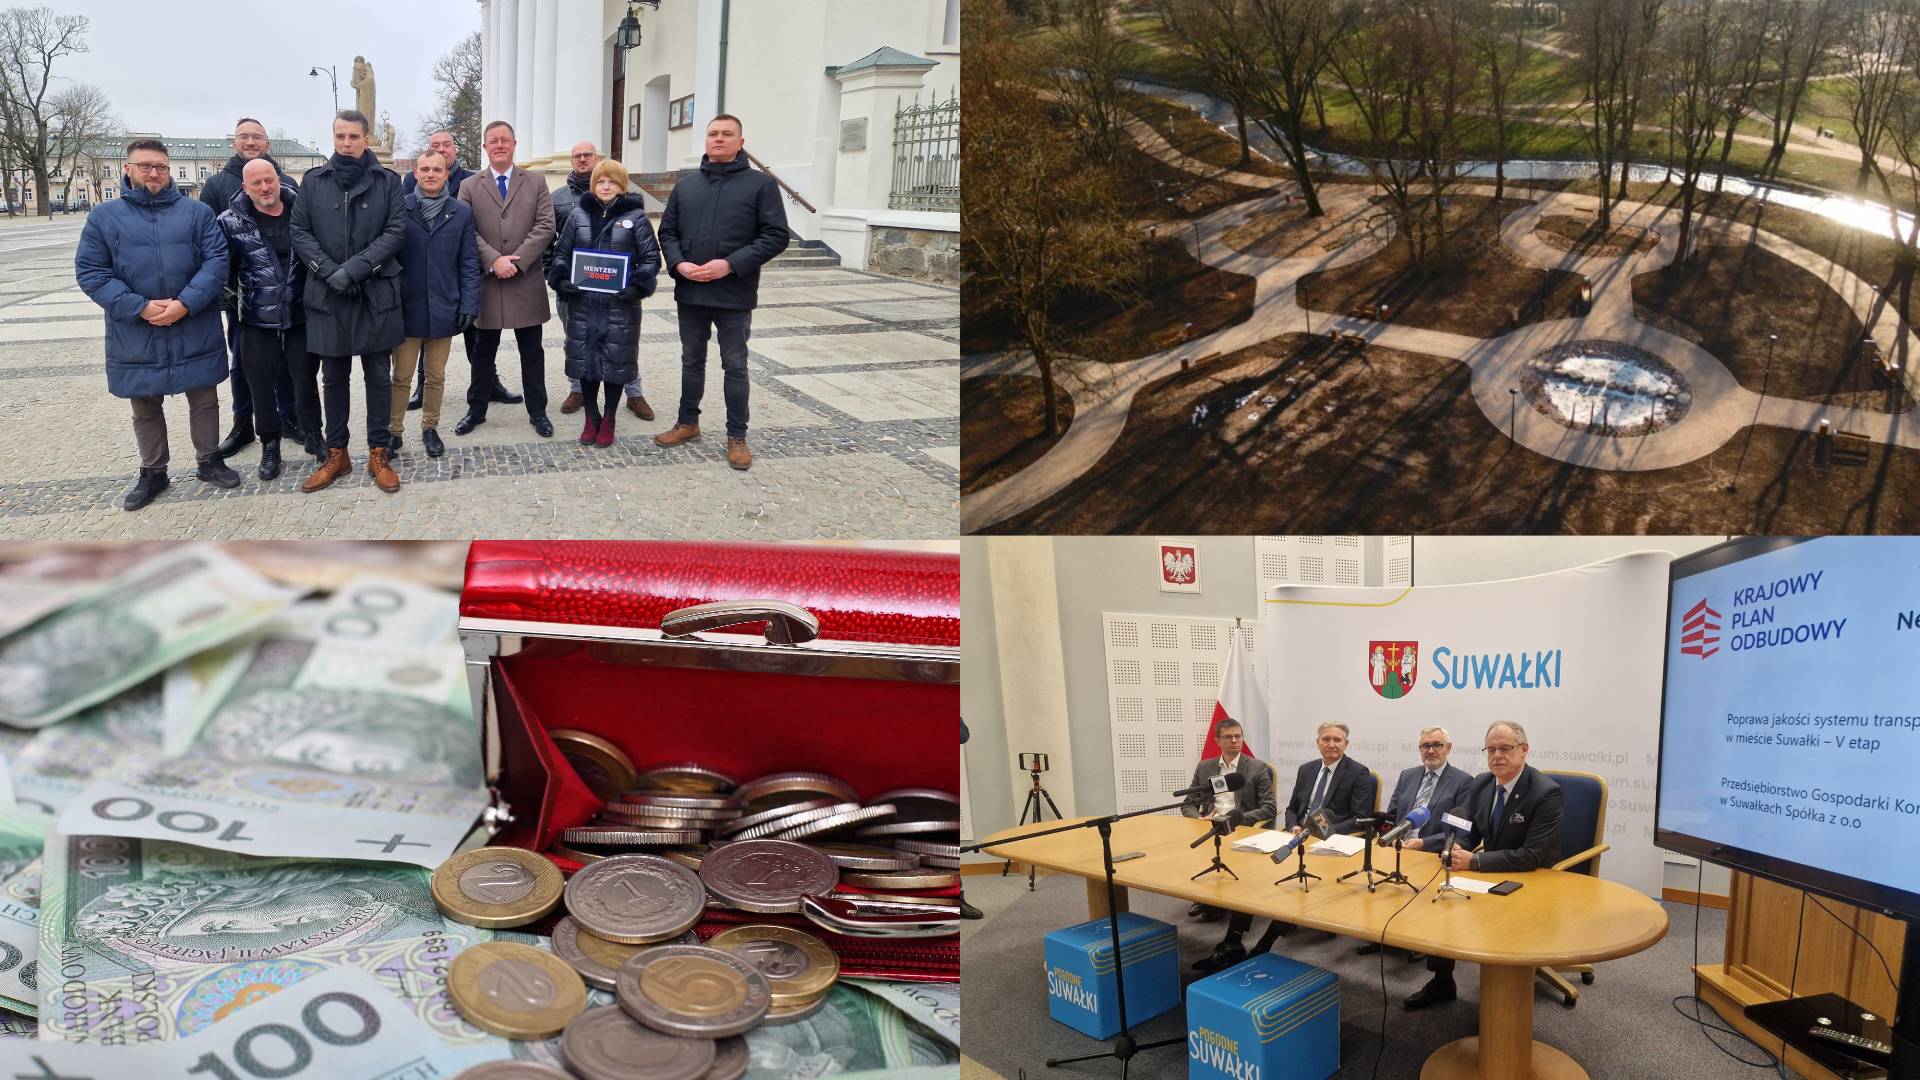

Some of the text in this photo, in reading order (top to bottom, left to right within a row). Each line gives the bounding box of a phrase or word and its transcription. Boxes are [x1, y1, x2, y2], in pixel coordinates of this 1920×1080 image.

[583, 265, 618, 274] MENTZEN
[1733, 570, 1824, 607] KRAJOWY
[1730, 618, 1848, 651] ODBUDOWY
[1731, 606, 1775, 630] PLAN
[1727, 713, 1769, 727] Poprawa
[1770, 711, 1811, 728] jakości
[1813, 713, 1869, 730] systemu
[1725, 734, 1733, 742] w
[1735, 731, 1773, 745] mieście
[1776, 733, 1820, 747] Suwałki
[1835, 736, 1846, 748] V
[1848, 737, 1880, 754] etap
[1721, 777, 1808, 799] Przedsiębiorstwo
[1811, 788, 1890, 811] Gospodarki
[92, 797, 254, 843] 100
[1730, 796, 1782, 816] Suwałkach
[1785, 804, 1825, 824] Spółka
[1829, 815, 1837, 825] z
[1840, 815, 1862, 829] o.o
[132, 970, 161, 1042] POLSKI
[1199, 1026, 1239, 1056] POGODNE
